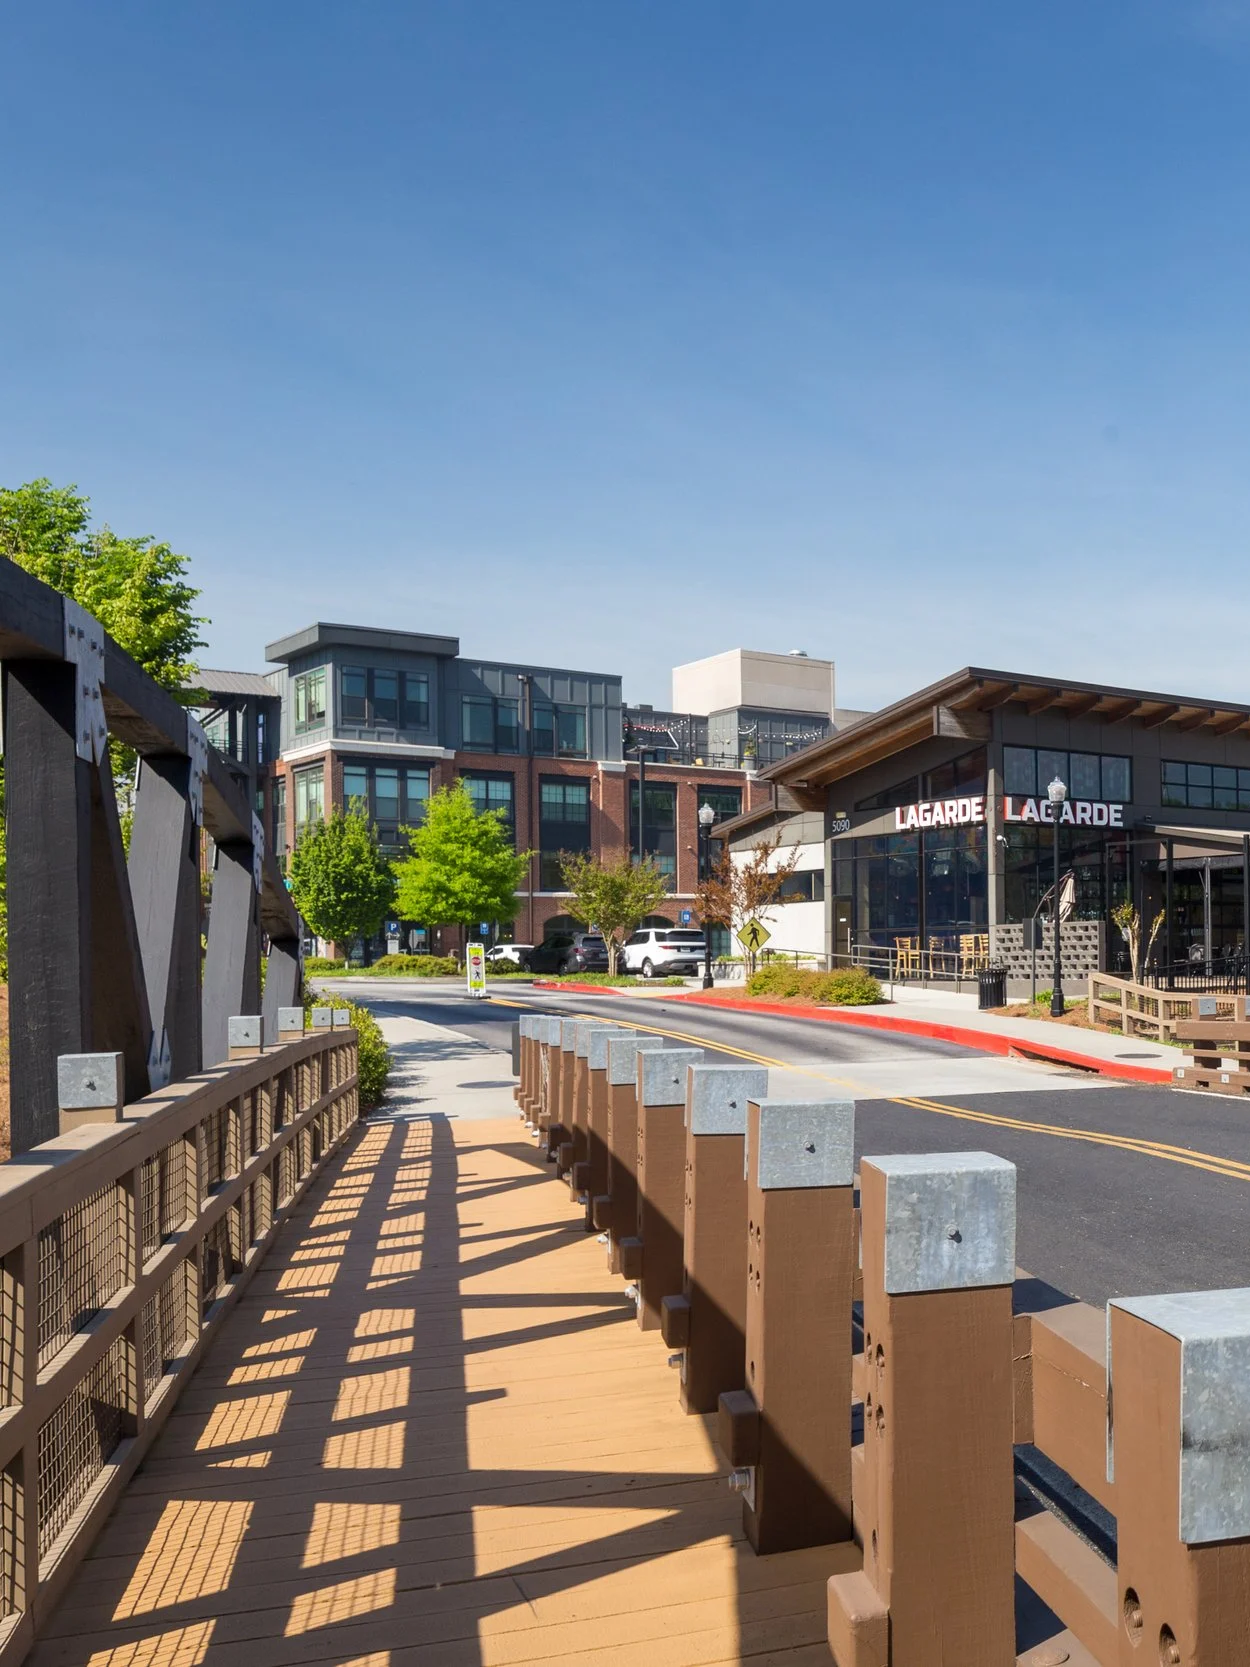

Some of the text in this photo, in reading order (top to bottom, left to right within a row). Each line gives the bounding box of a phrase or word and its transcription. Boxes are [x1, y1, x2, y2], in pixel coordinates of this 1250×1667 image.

[895, 797, 984, 830] LAGARDE
[1004, 796, 1124, 827] LAGARDE
[832, 818, 850, 832] 5090
[390, 923, 397, 931] P
